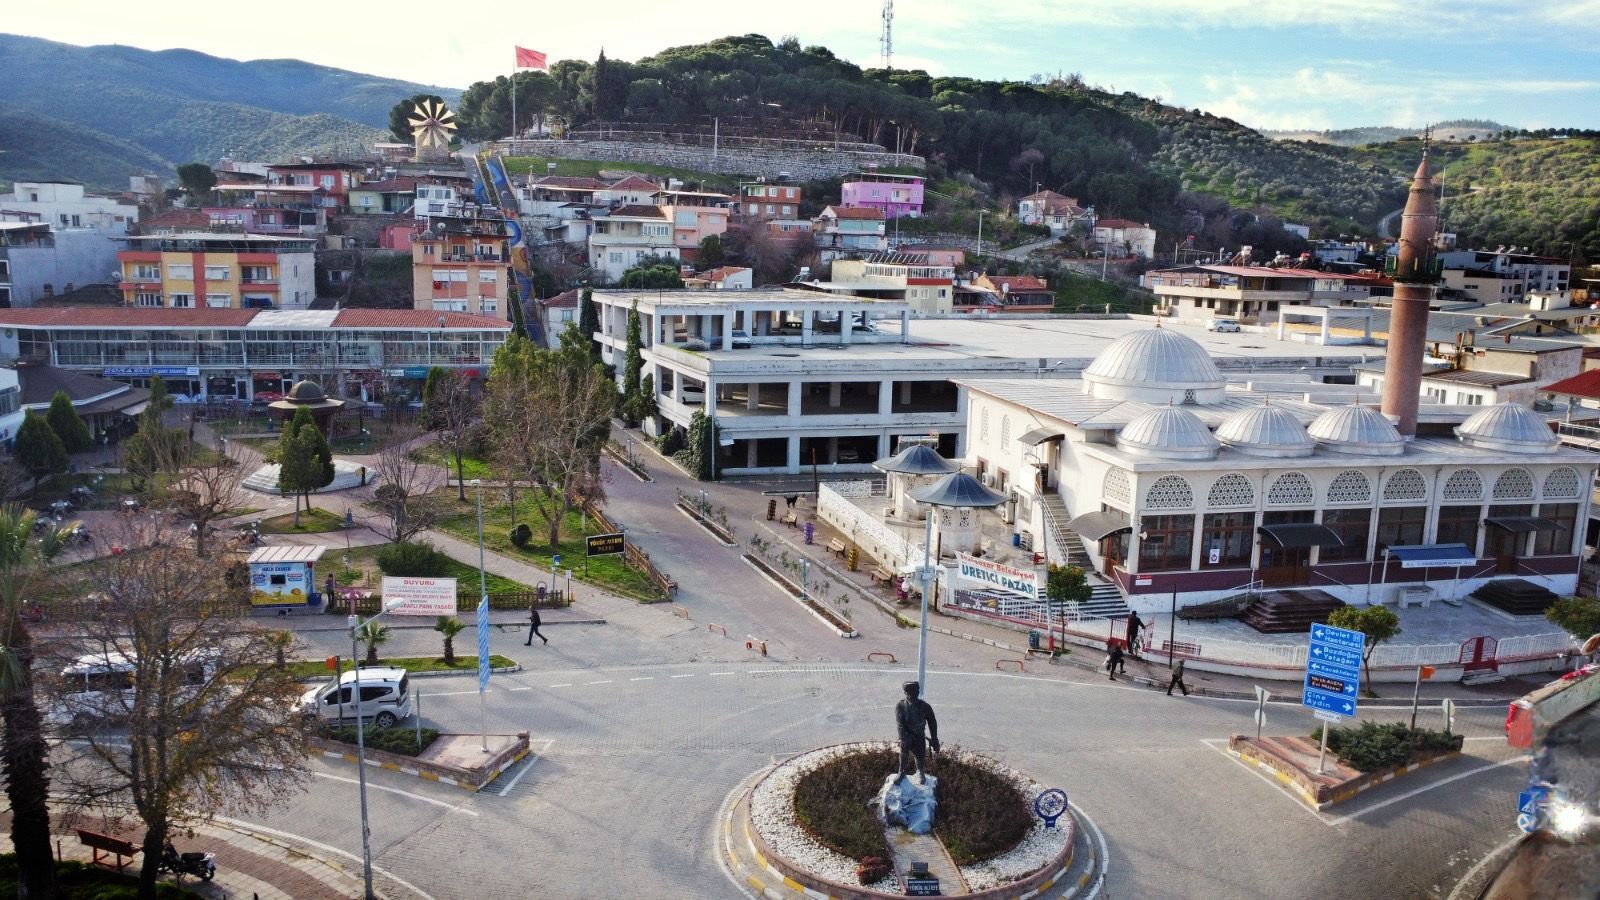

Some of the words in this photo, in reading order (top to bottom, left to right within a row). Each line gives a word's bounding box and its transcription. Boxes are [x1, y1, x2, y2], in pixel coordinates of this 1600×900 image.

[996, 563, 1035, 580] Belediyesi
[1325, 629, 1350, 639] Devlet
[1325, 636, 1361, 648] Hastanesi
[1324, 646, 1360, 659] Bozdoğan
[1324, 653, 1355, 665] Yatağan
[1306, 698, 1331, 709] Aydın
